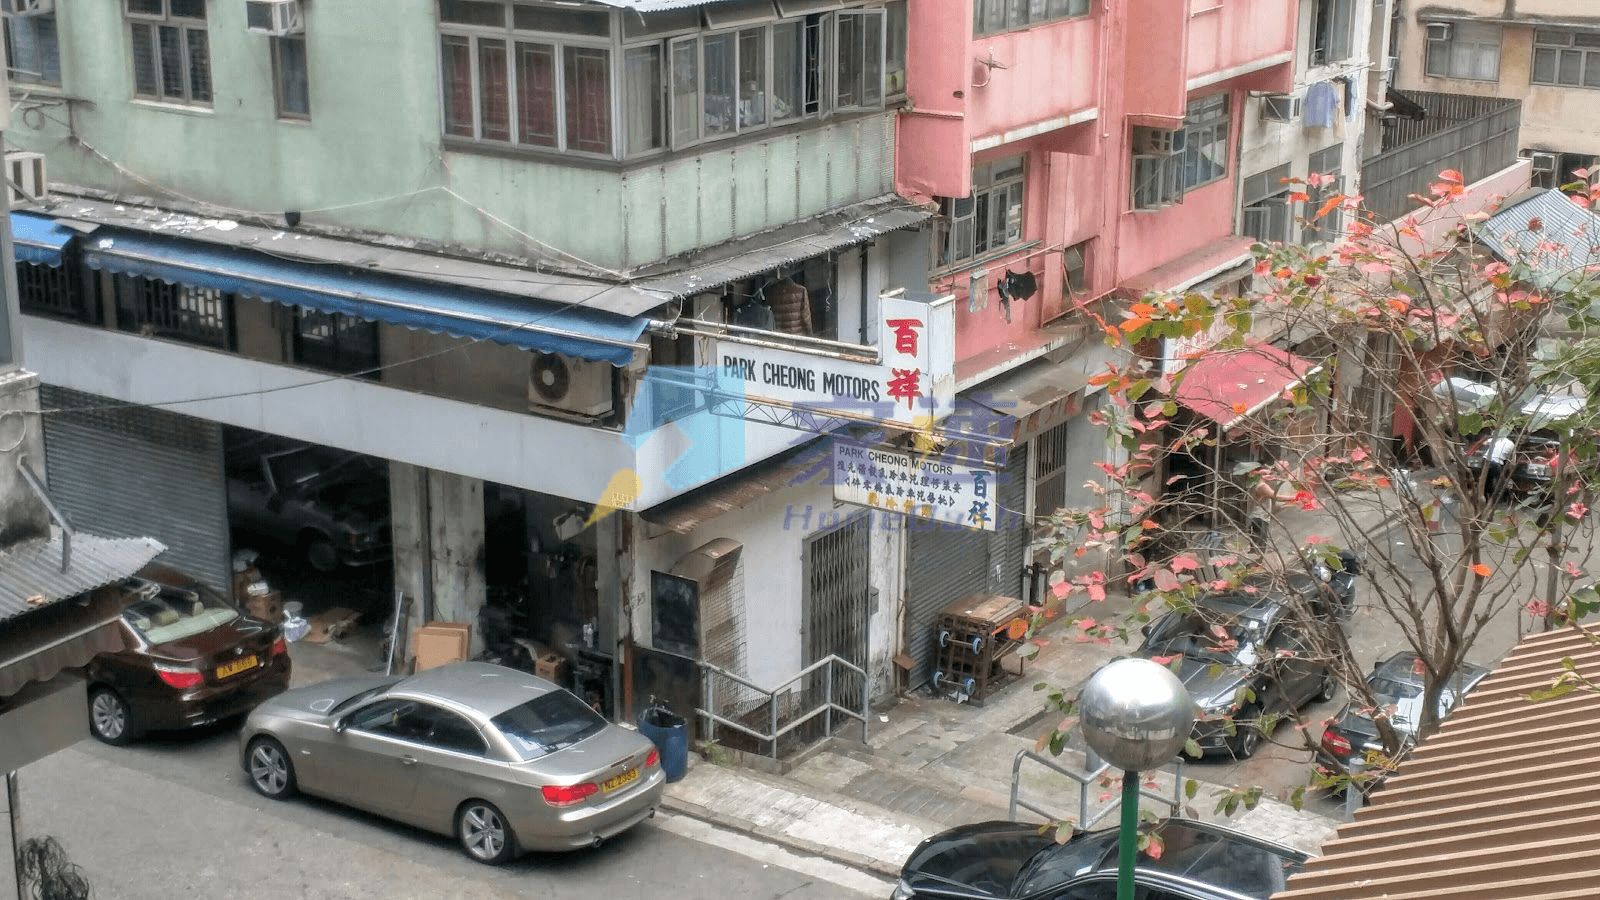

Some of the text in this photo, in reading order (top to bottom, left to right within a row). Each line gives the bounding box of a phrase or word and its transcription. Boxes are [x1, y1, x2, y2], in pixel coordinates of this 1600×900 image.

[723, 355, 880, 402] PARK CHEONG MOTORS
[885, 318, 924, 410] 百祥
[839, 446, 953, 475] PARK CHEONG MOTORS
[967, 470, 992, 529] 百祥
